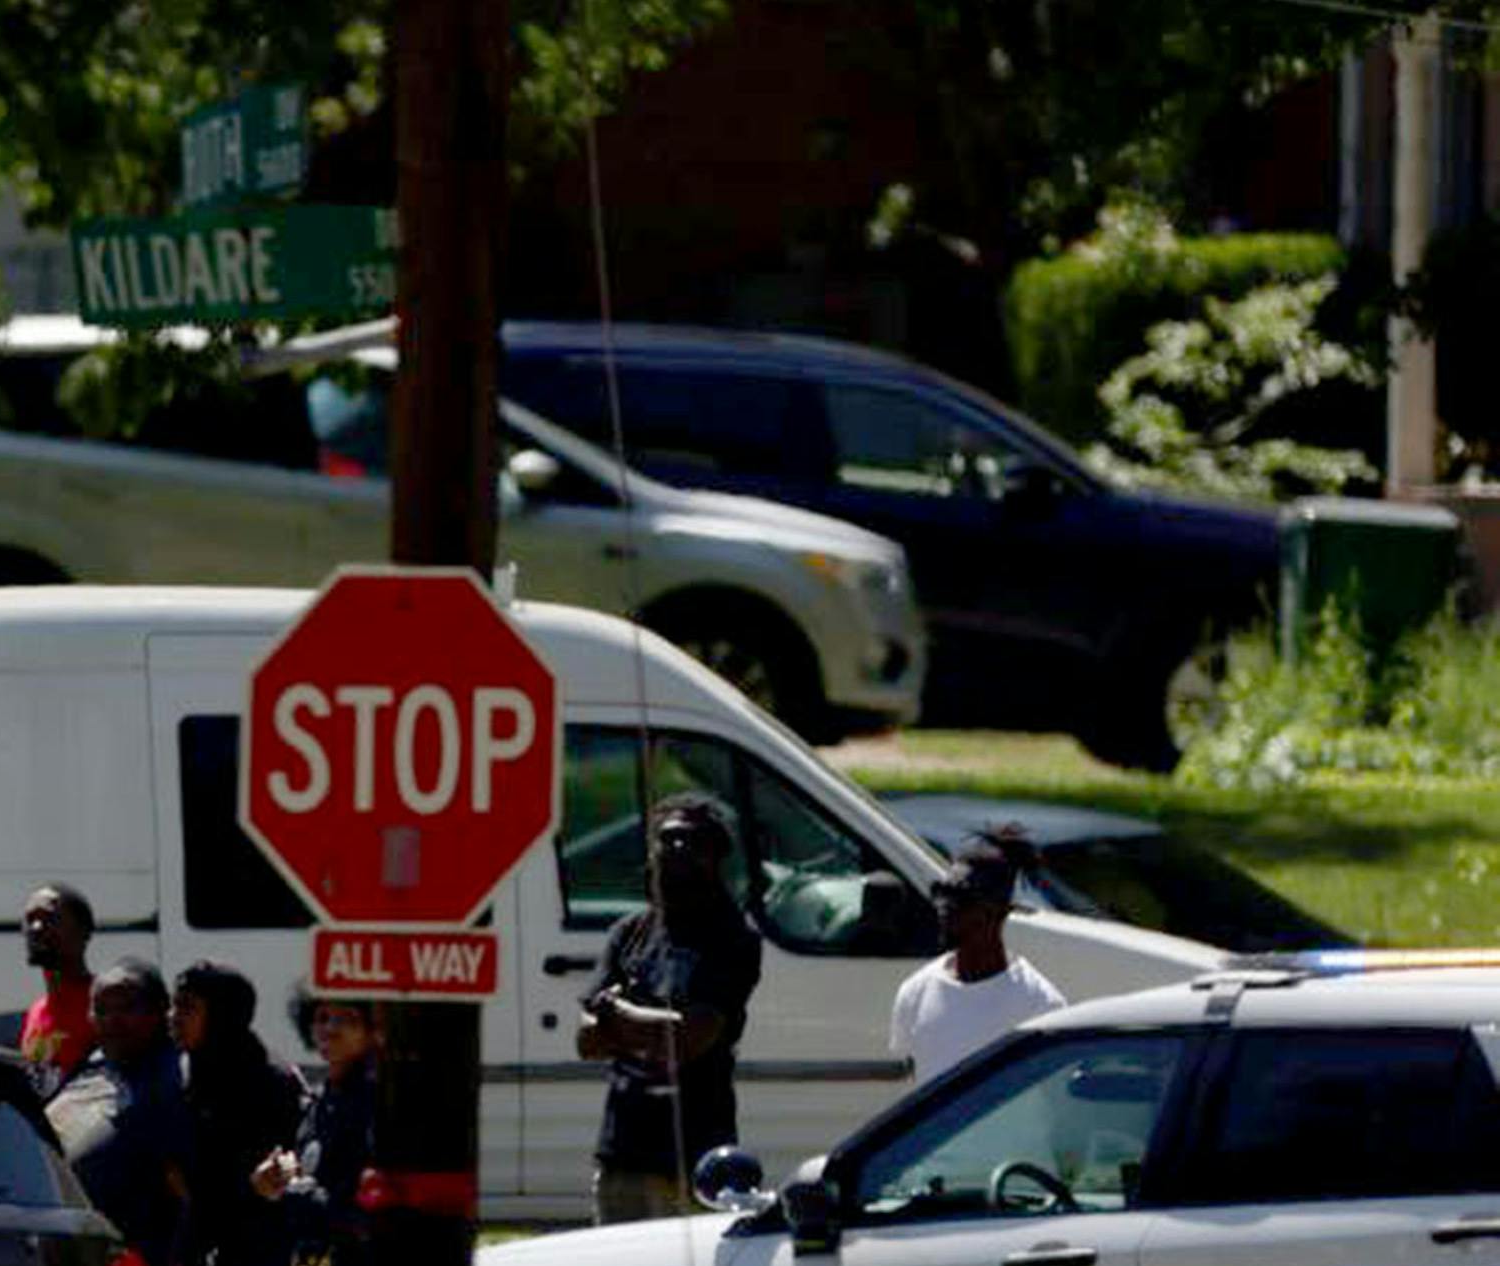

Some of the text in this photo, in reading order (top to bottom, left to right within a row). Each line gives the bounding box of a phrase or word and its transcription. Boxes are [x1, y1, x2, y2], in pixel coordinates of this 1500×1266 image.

[79, 227, 280, 311] KILDARE
[266, 683, 536, 815] STOP
[326, 942, 485, 983] ALL WAY
